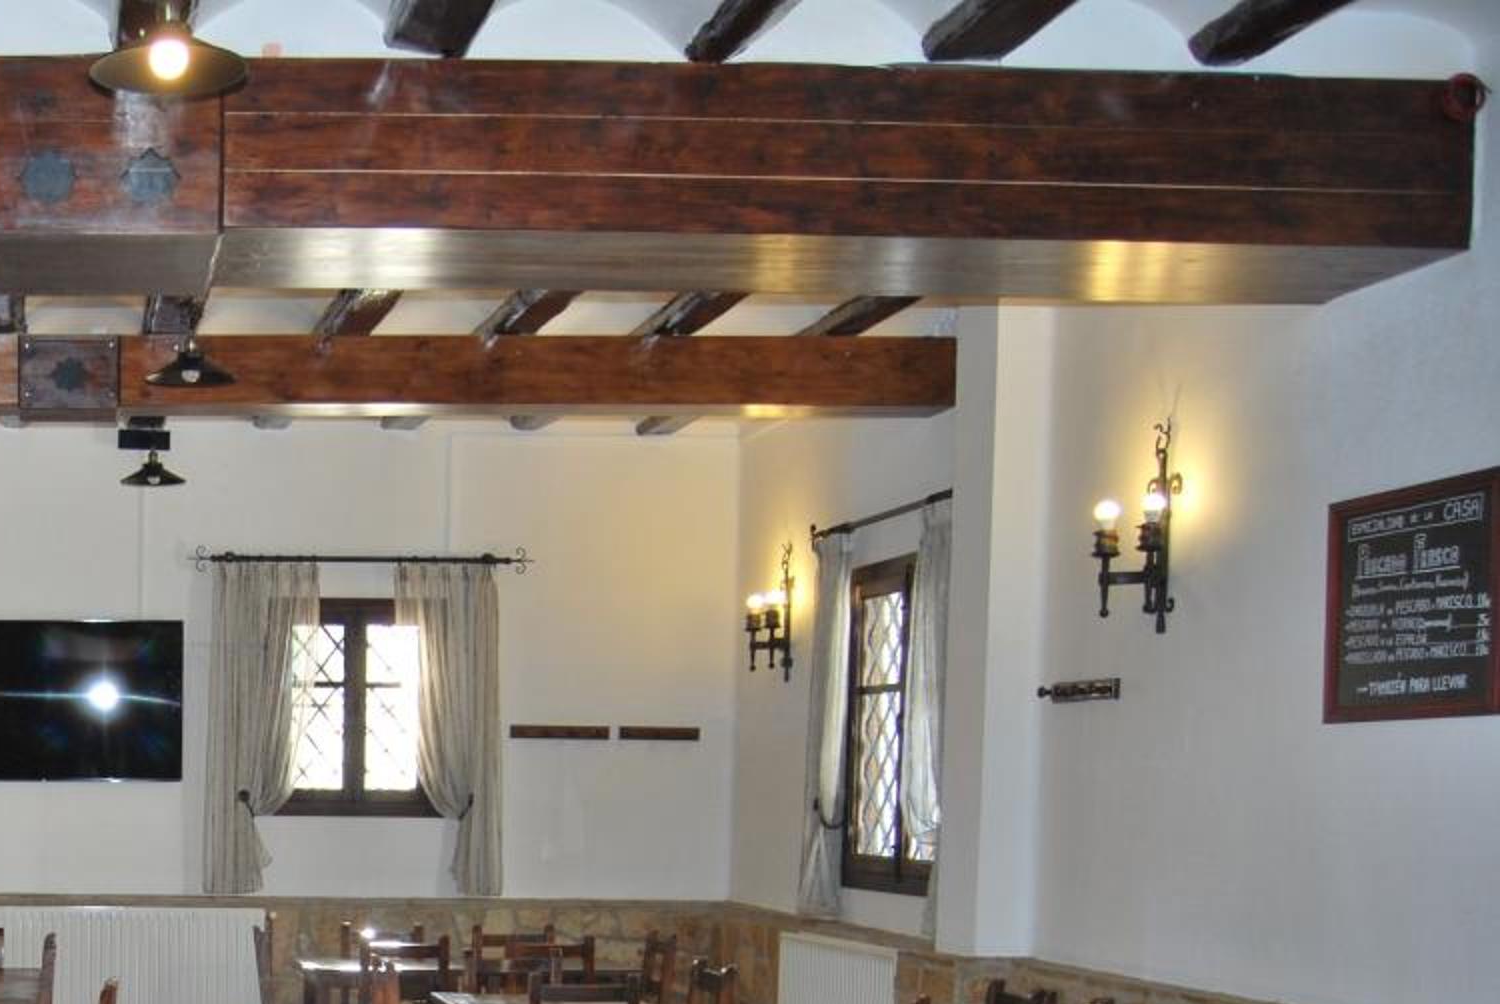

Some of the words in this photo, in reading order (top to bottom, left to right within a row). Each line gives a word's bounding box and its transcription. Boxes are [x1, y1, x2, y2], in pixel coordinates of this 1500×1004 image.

[1443, 499, 1479, 519] CASA
[1410, 676, 1430, 694] PARA
[1432, 674, 1468, 692] LLEVAR
